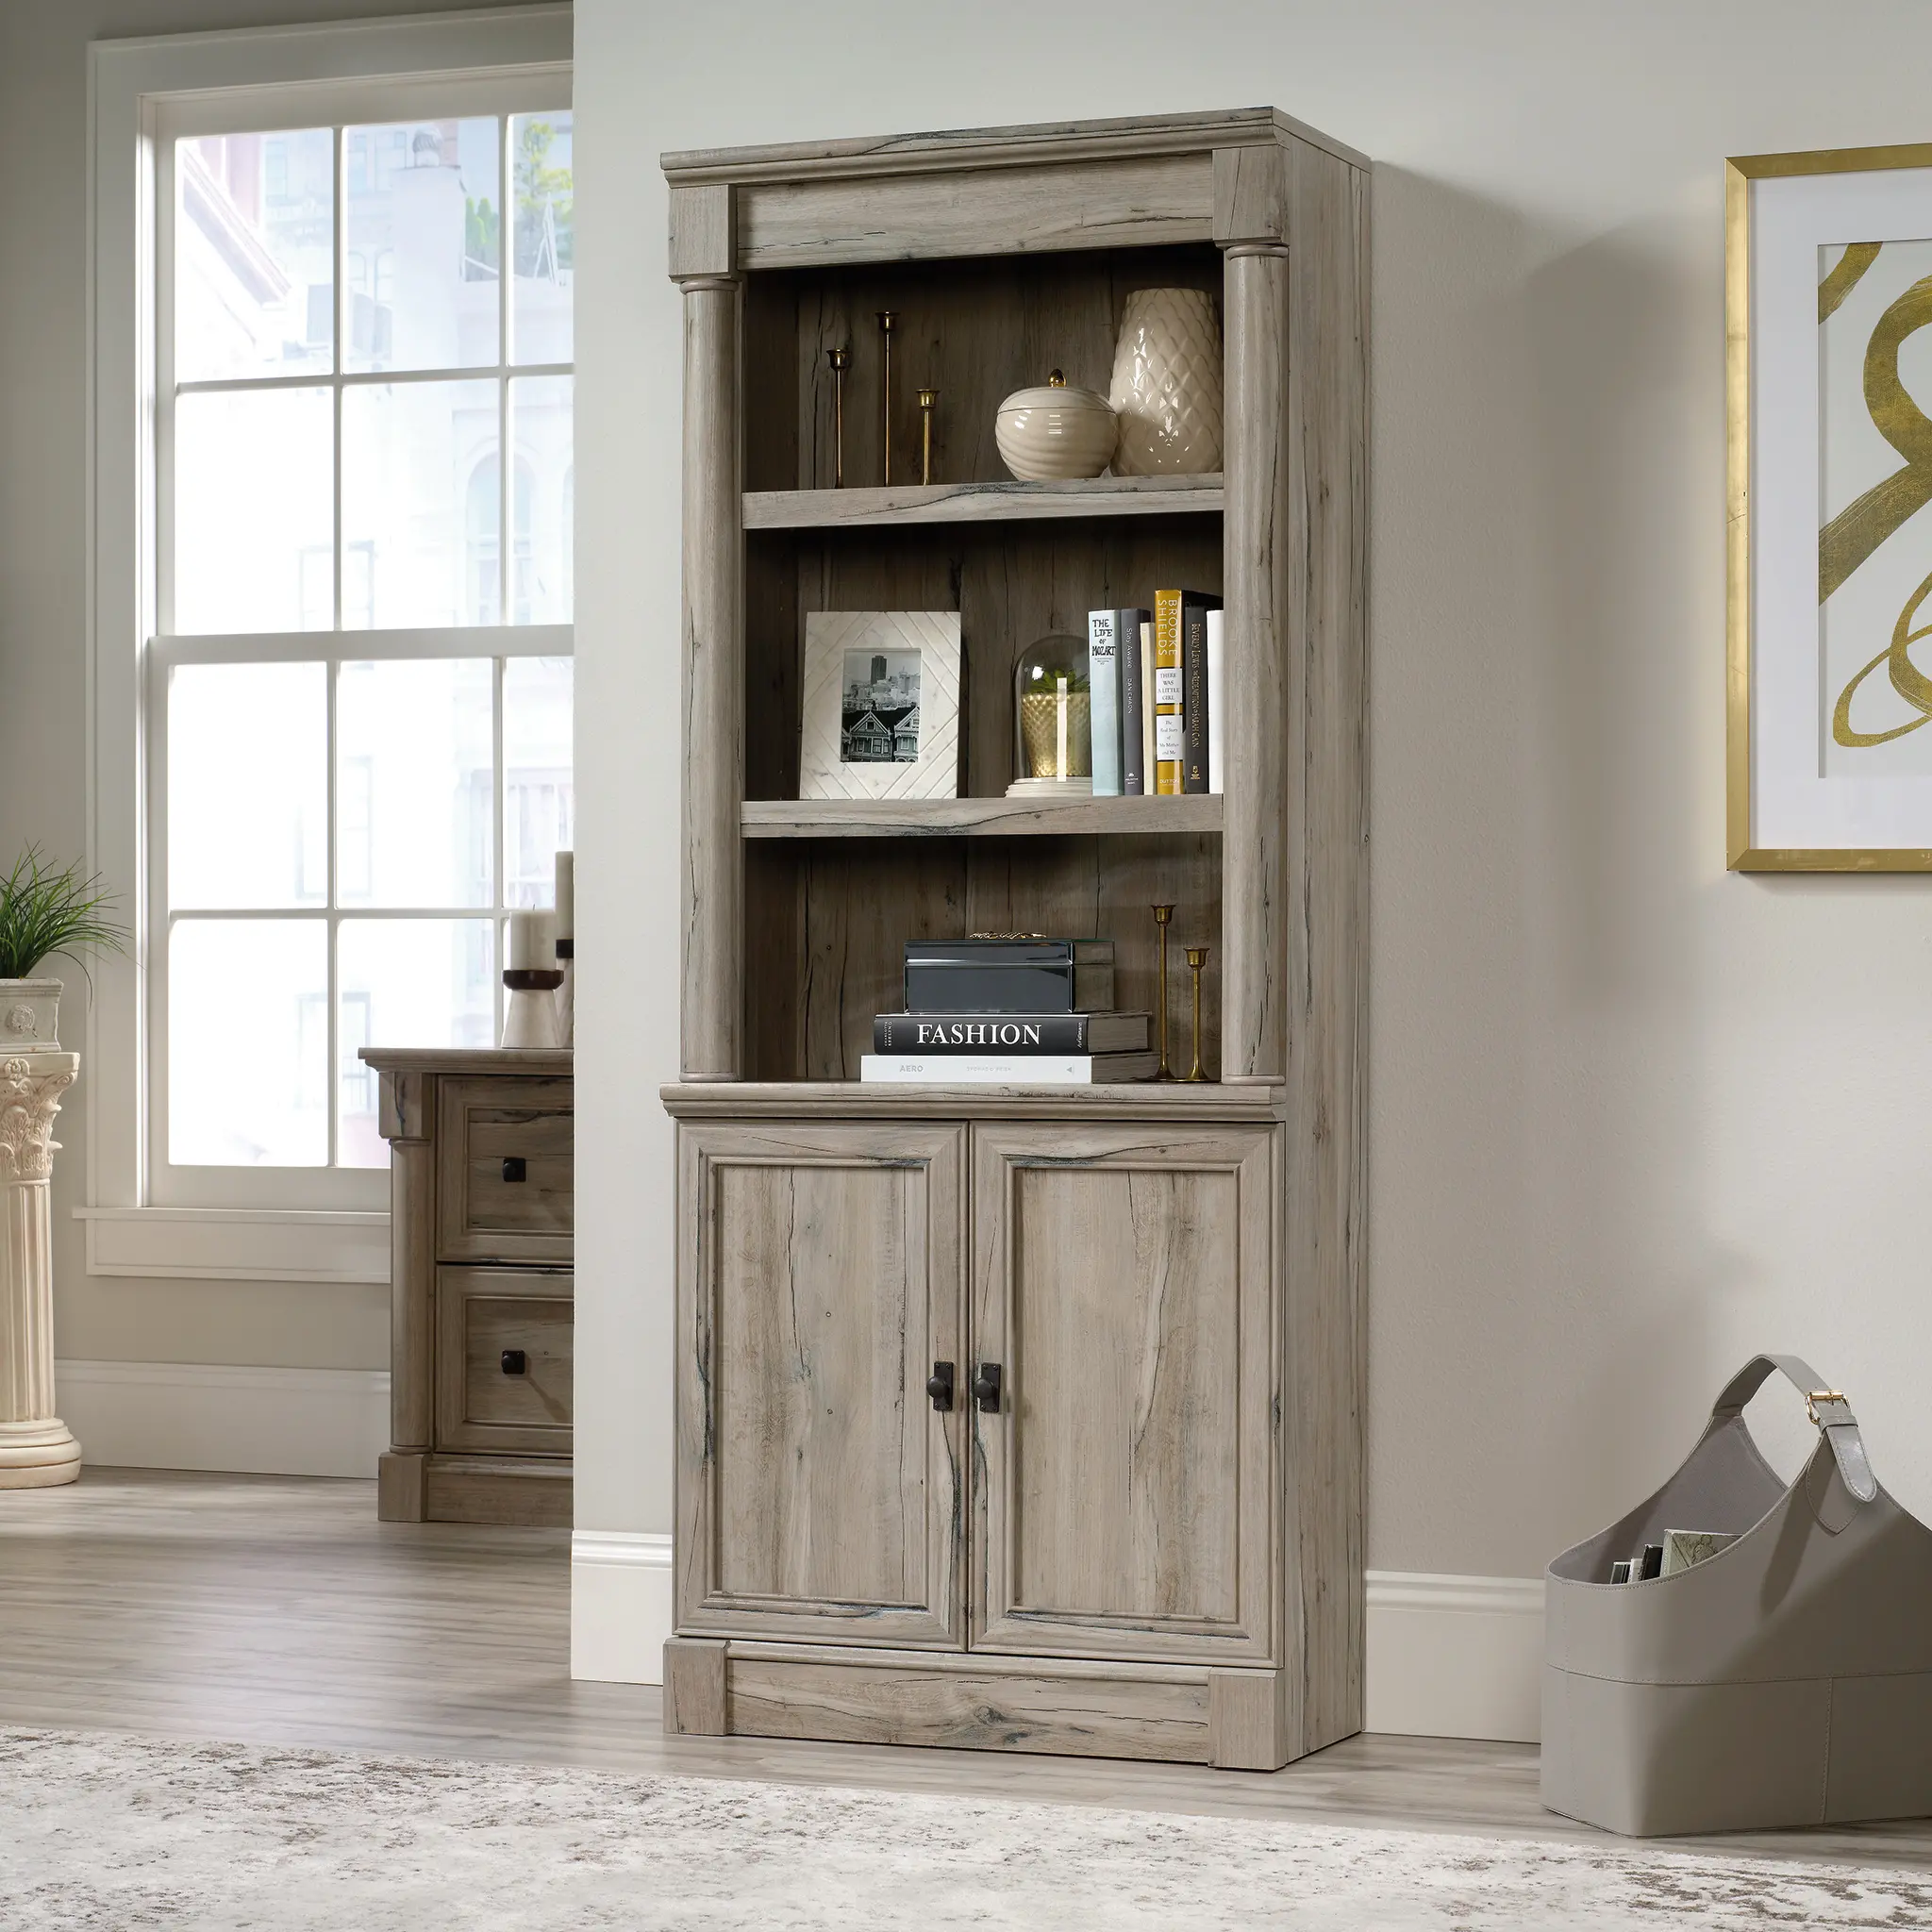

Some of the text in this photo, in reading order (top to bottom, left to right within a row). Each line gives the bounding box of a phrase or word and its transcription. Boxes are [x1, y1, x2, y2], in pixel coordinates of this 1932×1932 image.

[1092, 619, 1109, 627] THE
[1158, 599, 1168, 656] SHIELDS
[1168, 599, 1178, 656] BROOKE
[1094, 628, 1113, 638] LIFE
[1091, 646, 1116, 656] MOZART
[917, 1024, 1041, 1044] FASHION
